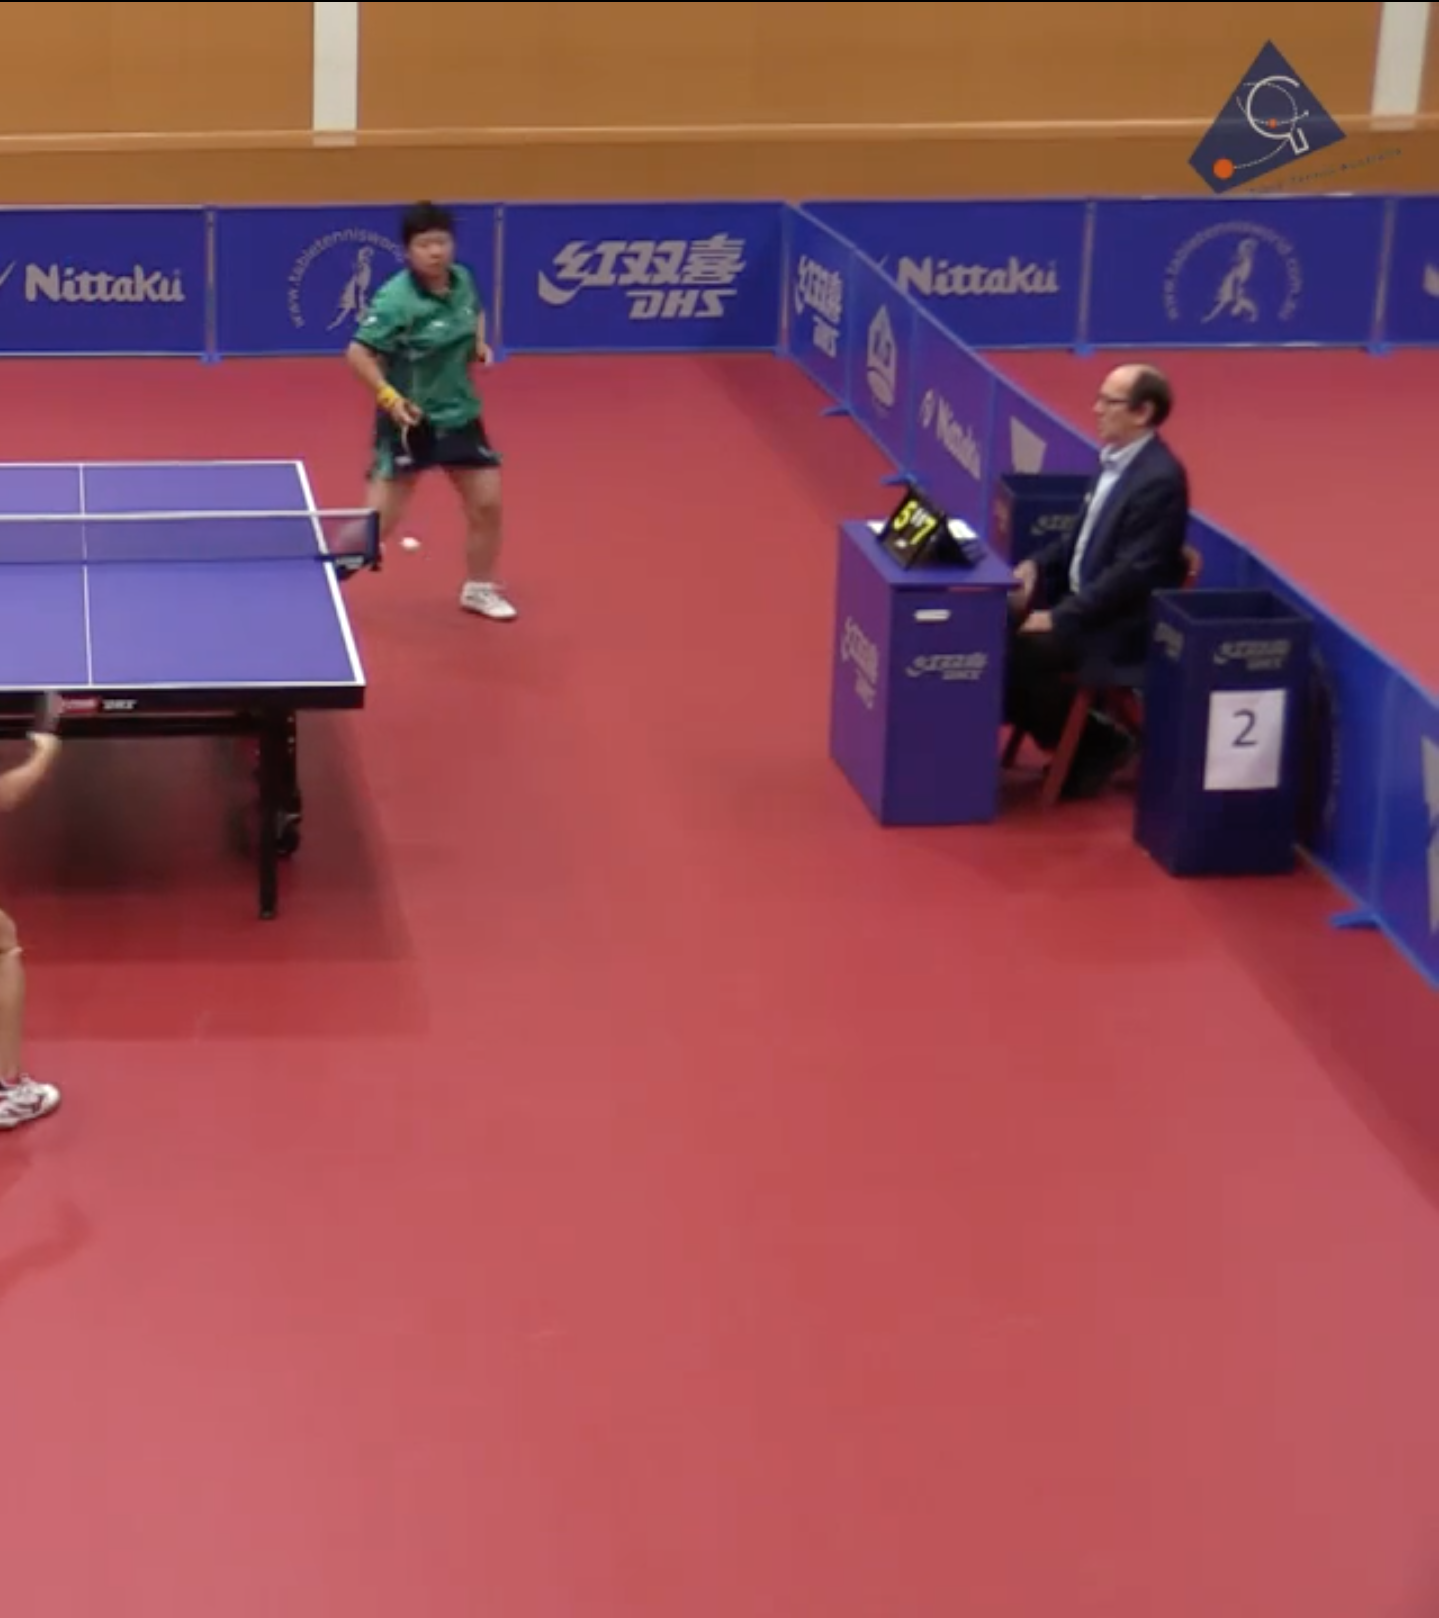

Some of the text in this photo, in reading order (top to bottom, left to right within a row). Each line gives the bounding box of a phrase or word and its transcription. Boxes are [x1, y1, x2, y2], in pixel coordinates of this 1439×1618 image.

[538, 232, 747, 305] 红双喜
[625, 289, 738, 321] DHS
[893, 500, 918, 531] 5
[909, 516, 936, 545] 7
[1232, 708, 1258, 747] 2
